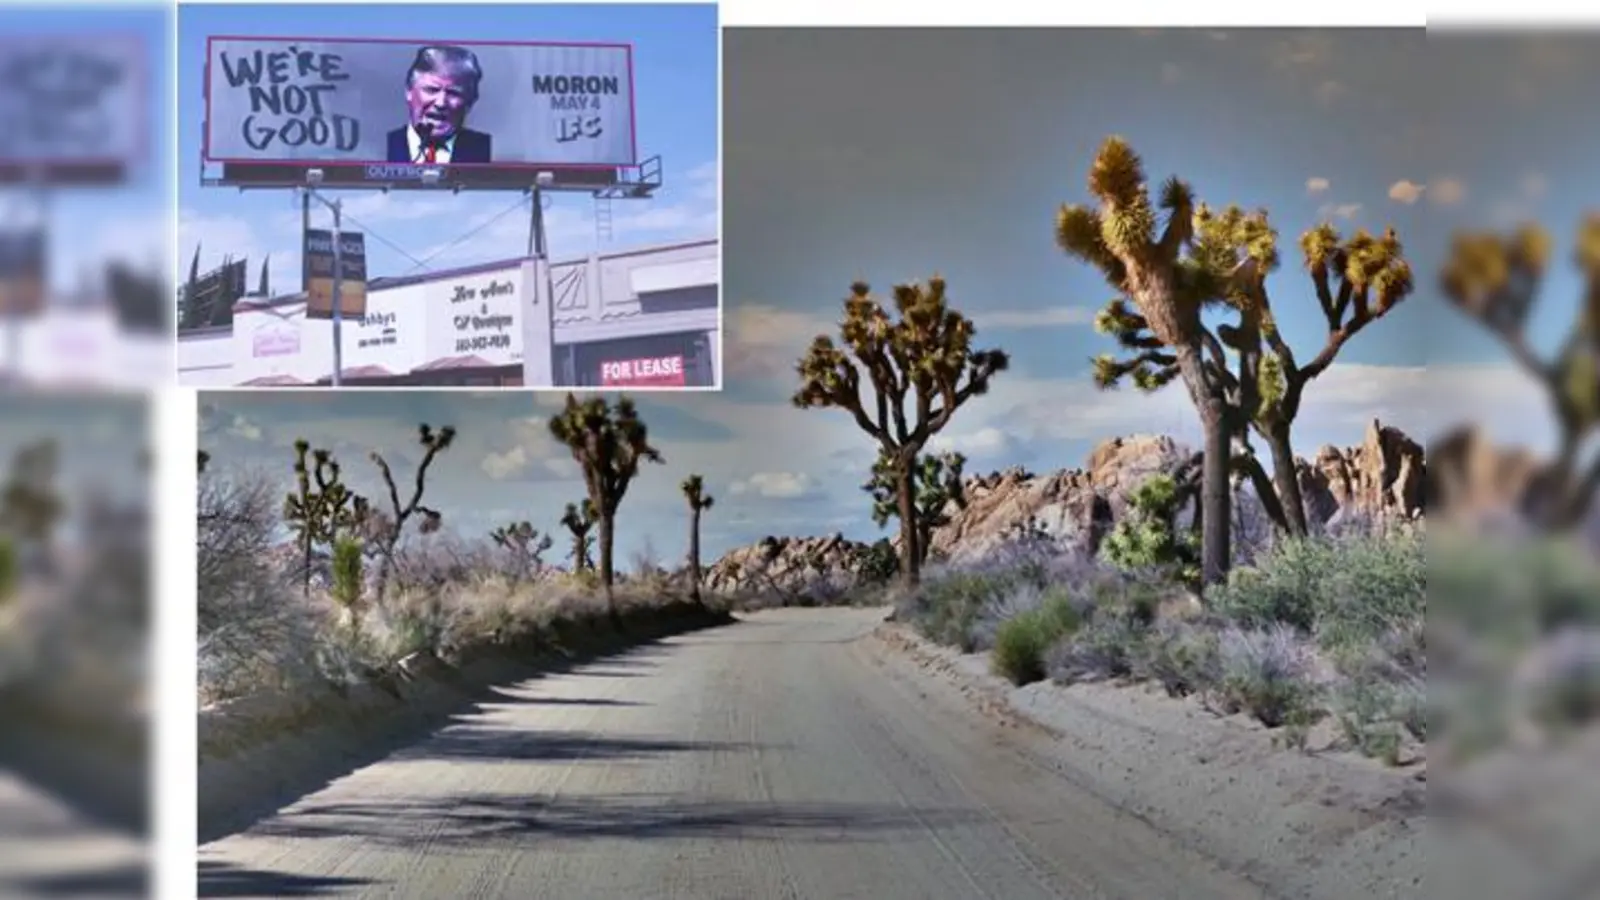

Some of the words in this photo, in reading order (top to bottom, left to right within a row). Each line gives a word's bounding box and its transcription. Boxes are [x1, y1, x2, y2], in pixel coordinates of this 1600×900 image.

[220, 46, 350, 88] WE'RE
[532, 75, 618, 95] MORON
[248, 84, 337, 116] NOT
[550, 95, 588, 110] MAY
[590, 96, 601, 110] 4
[242, 114, 360, 152] GOOD
[602, 361, 632, 380] FOR
[635, 356, 682, 376] LEASE
